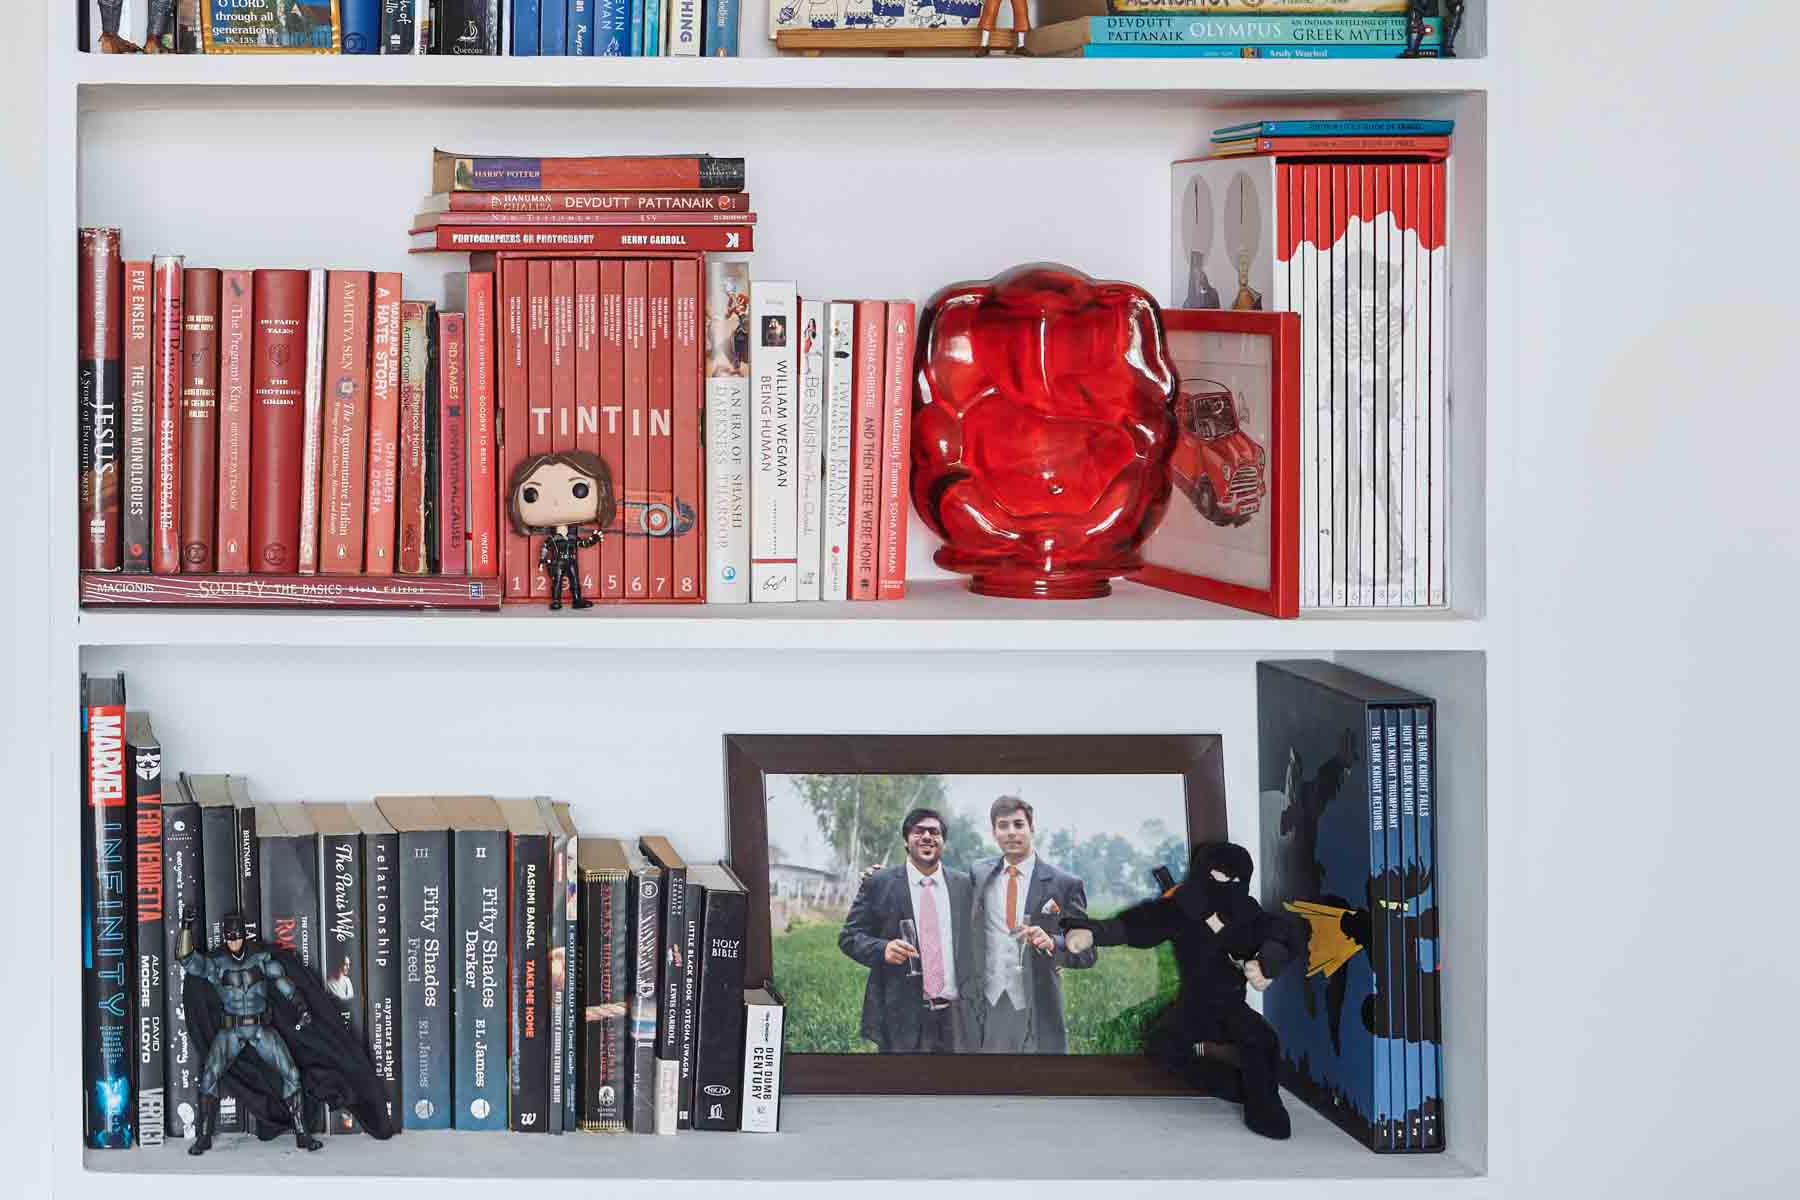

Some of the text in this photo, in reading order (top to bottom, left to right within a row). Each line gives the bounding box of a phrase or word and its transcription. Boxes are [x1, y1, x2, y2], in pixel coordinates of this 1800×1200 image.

[212, 26, 278, 36] generations.
[215, 11, 273, 23] through all
[1108, 22, 1281, 42] PATTANAIK OLYMPUS
[1293, 28, 1404, 41] GREEK MYTHS
[565, 197, 713, 210] DEVDUTT PATTANAIK
[621, 235, 686, 245] HENRY CARROLL
[131, 270, 145, 339] EVE ENSLER
[375, 306, 389, 400] HATE STORY
[130, 366, 145, 516] THE VAGINA MONOLOGUES
[531, 406, 671, 436] TINTIN
[760, 376, 772, 472] BEING HUMAN
[777, 360, 788, 488] WILLIAM WEGMAN
[97, 581, 342, 598] MACIONIS SOCIETY THE BASICS
[91, 714, 122, 800] MARVEL
[98, 822, 124, 1016] INFINITY
[376, 845, 388, 967] relationship
[526, 864, 535, 950] RASHMI BANSAL
[408, 936, 420, 983] Freed
[422, 886, 440, 1008] Fifty Shades
[465, 930, 478, 988] Darker
[480, 888, 498, 1010] Fifty Shades
[712, 938, 740, 949] HOLY
[712, 949, 739, 958] BIBLE
[141, 955, 150, 1008] MOORE
[151, 955, 161, 986] ALAN
[141, 1017, 151, 1064] LLOYD
[152, 1016, 160, 1052] DAVID
[752, 1047, 764, 1100] CENTURY
